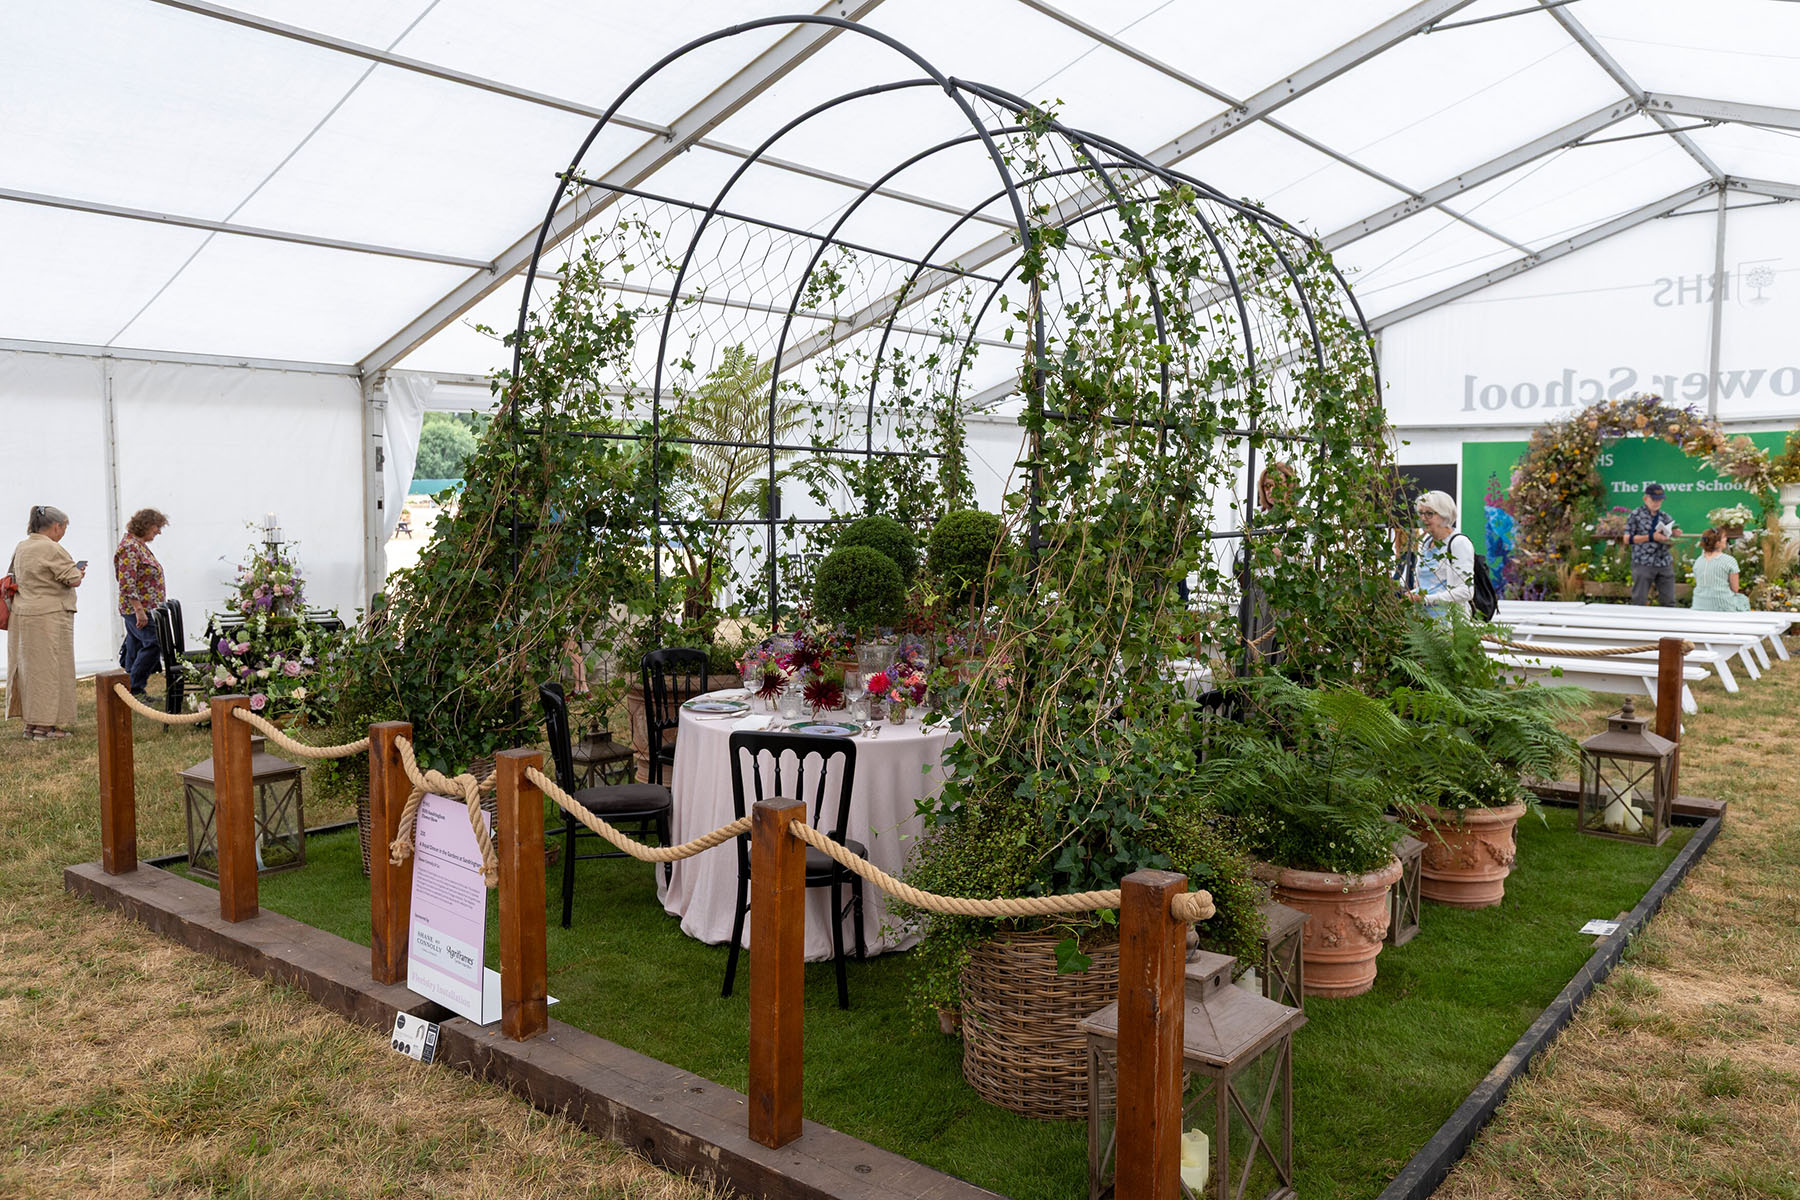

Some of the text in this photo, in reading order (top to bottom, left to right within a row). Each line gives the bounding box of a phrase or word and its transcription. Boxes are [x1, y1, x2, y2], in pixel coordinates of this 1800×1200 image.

[1595, 453, 1614, 467] HS
[1611, 481, 1639, 492] The
[1642, 480, 1694, 492] Fower
[417, 938, 442, 953] CONNOLLY
[446, 945, 474, 966] Agriframes
